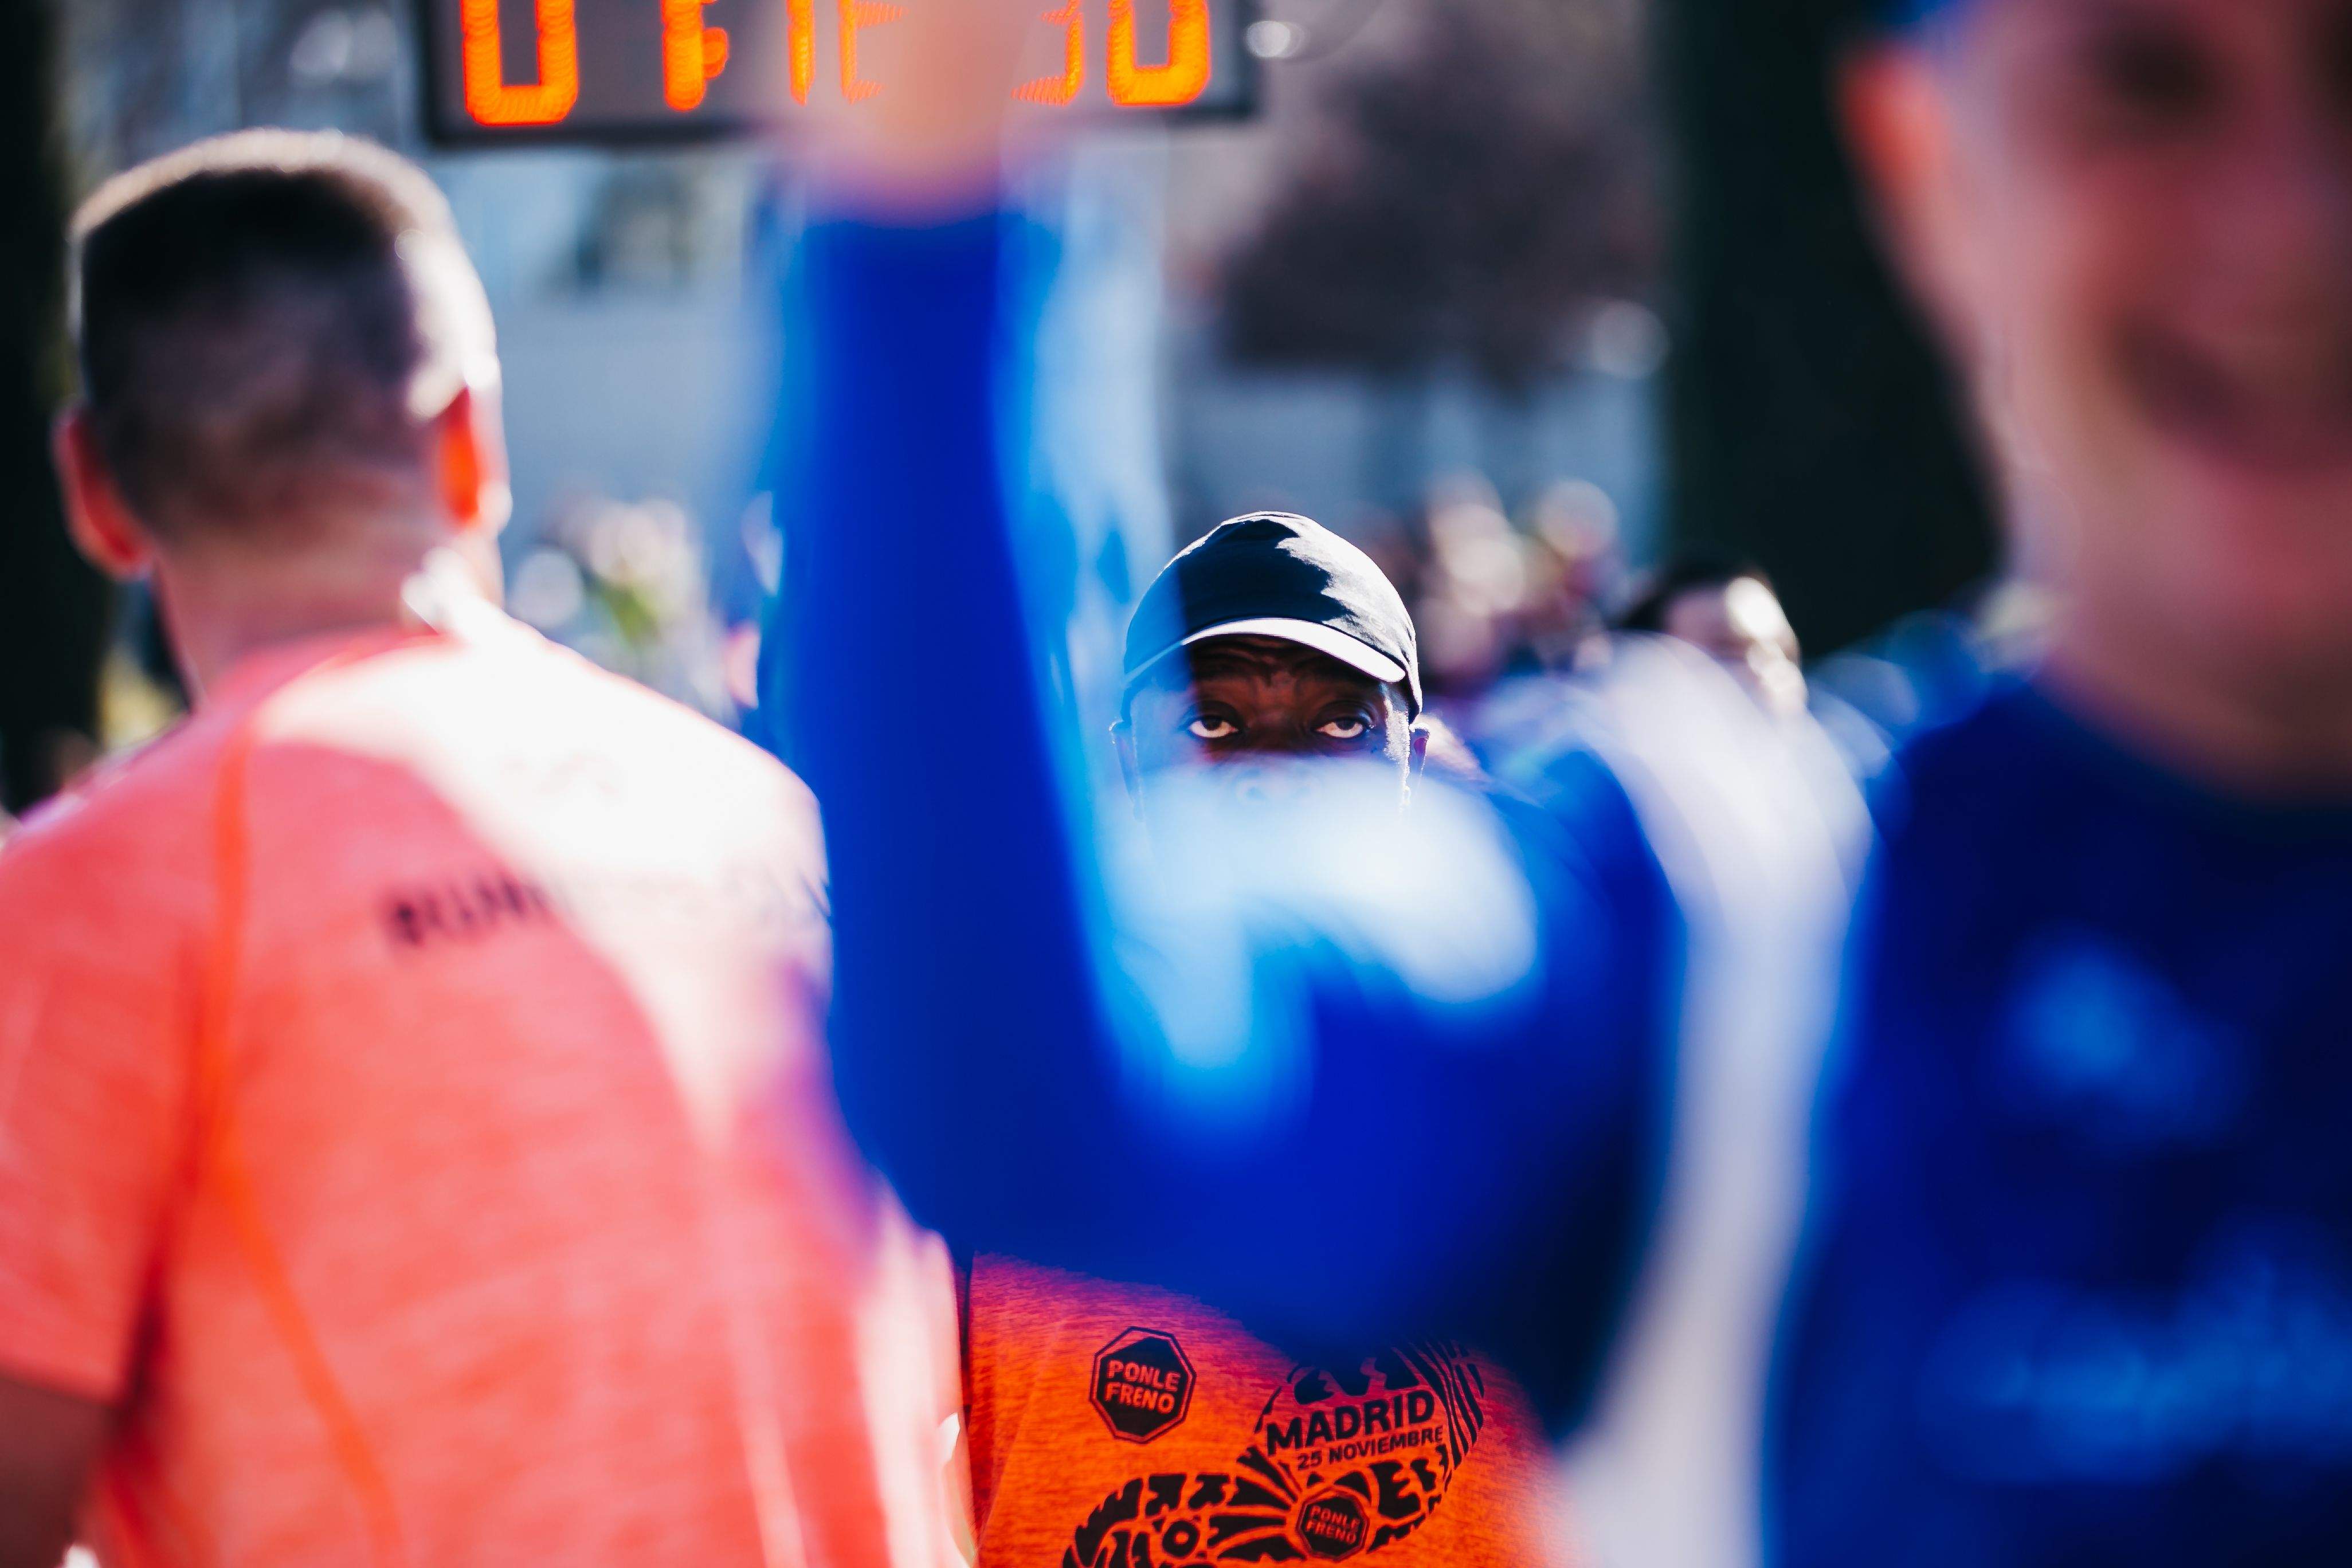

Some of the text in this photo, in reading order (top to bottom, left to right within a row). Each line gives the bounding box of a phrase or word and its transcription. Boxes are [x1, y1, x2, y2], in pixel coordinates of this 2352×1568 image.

[1106, 1359, 1181, 1392] PONLE
[1105, 1381, 1175, 1414] FRENO
[1267, 1390, 1434, 1456] MADRID
[1297, 1425, 1444, 1471] 25 NOVIEMBRE
[1306, 1519, 1357, 1545] FRENO
[1310, 1505, 1360, 1532] PONLE
